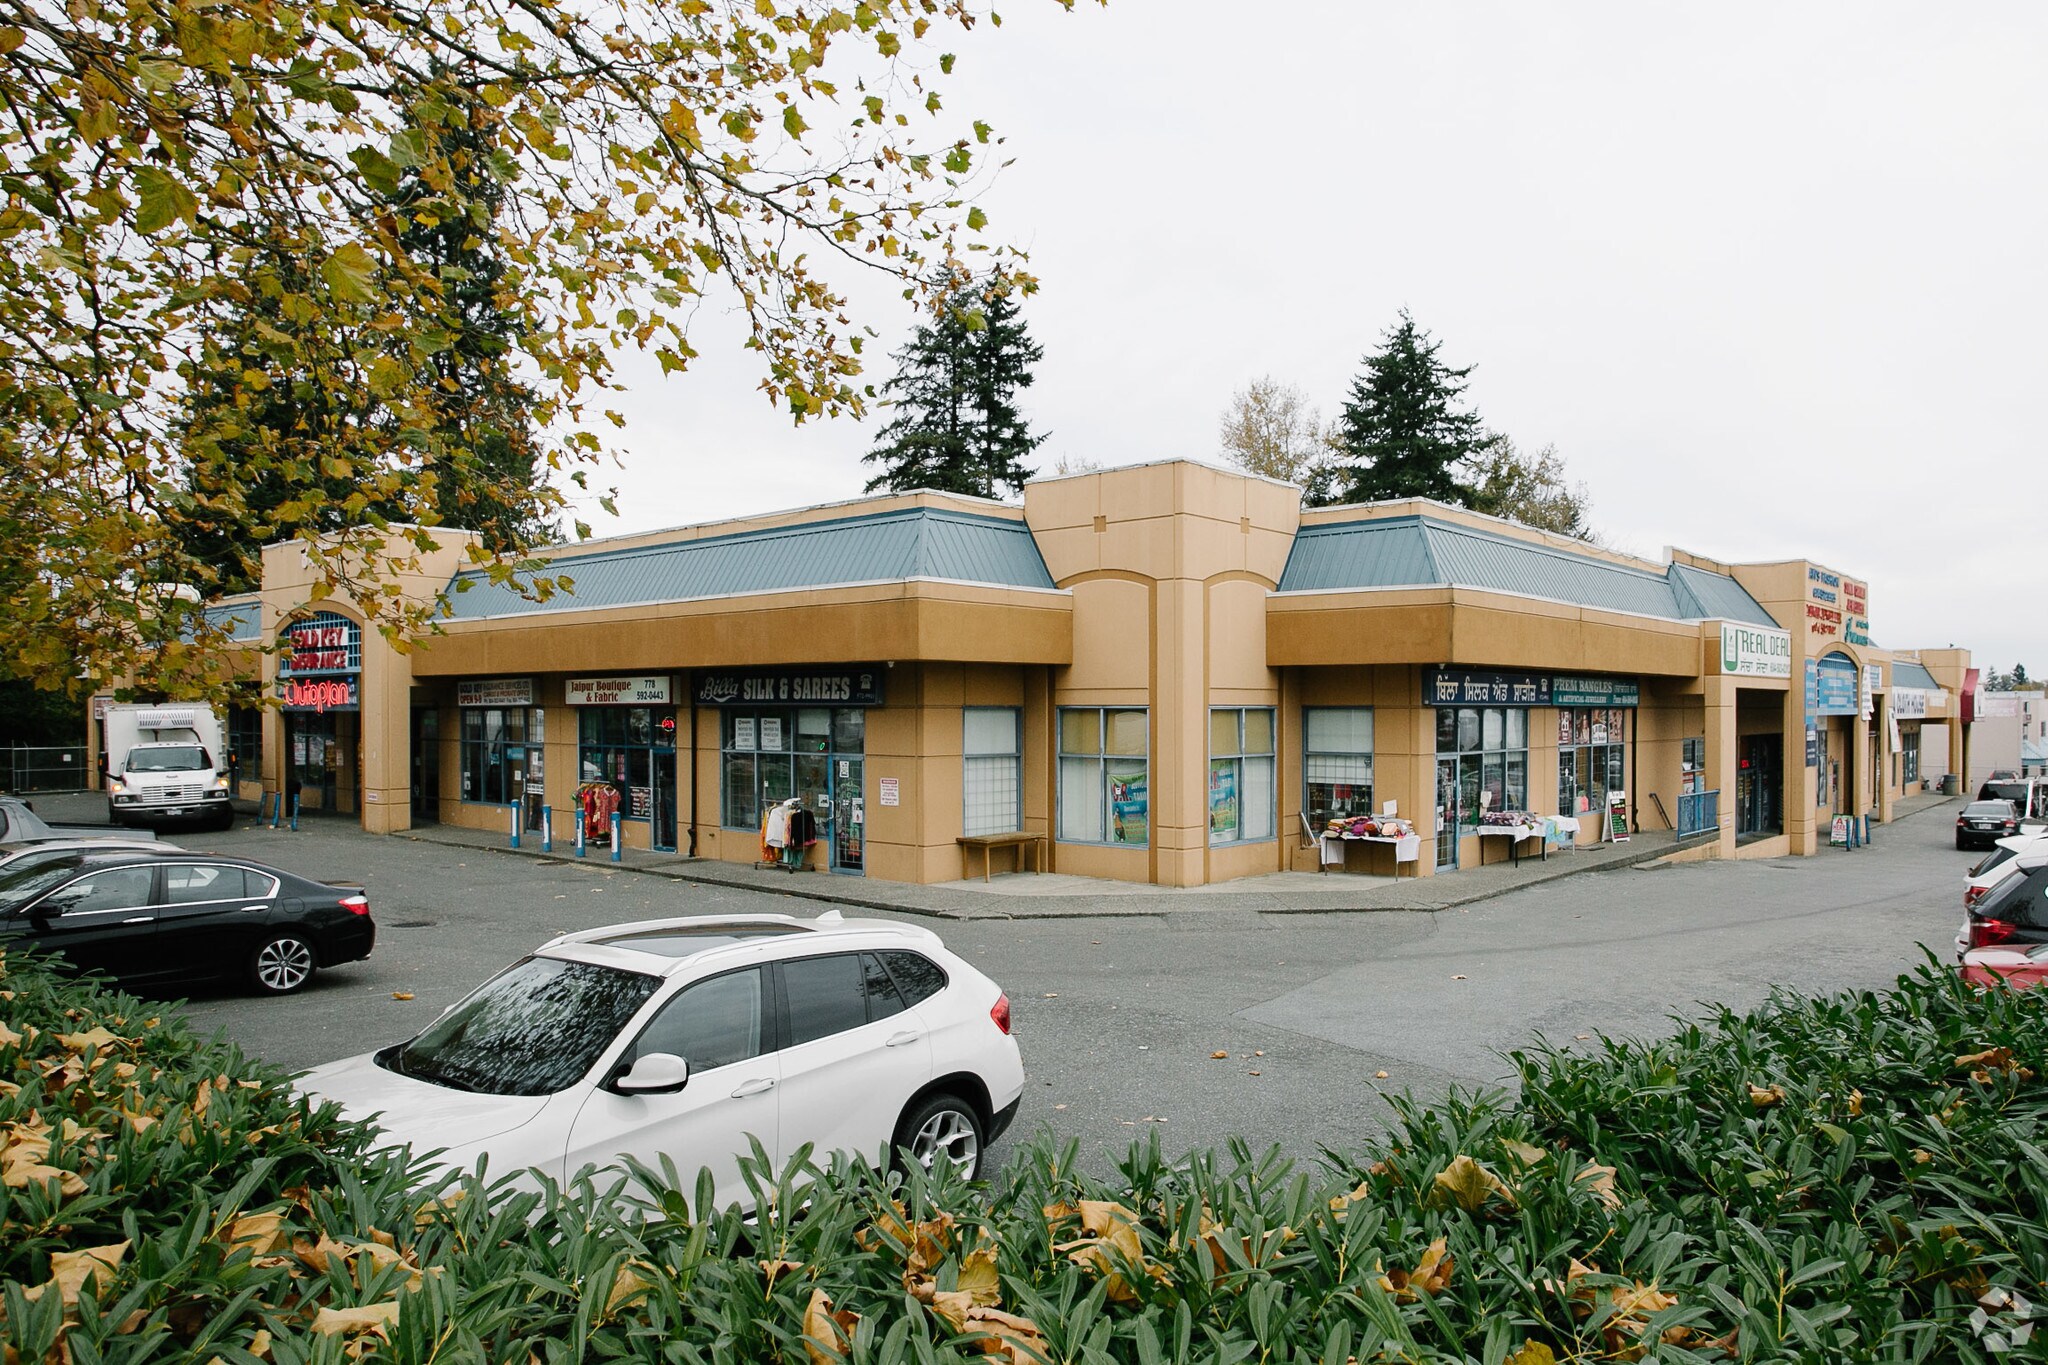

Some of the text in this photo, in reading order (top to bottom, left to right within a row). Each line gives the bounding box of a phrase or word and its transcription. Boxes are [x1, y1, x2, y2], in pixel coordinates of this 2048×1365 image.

[321, 627, 344, 647] KEY
[1741, 629, 1791, 657] REAL DEAL
[571, 680, 631, 693] Jaipur Boutique
[645, 680, 655, 689] 778
[700, 677, 850, 702] Billa SILK & SAREES
[1553, 678, 1577, 692] PREM
[1579, 680, 1612, 693] BANGLES
[284, 678, 348, 713] Autoplan
[585, 692, 618, 702] & Fabric
[636, 691, 664, 700] 592-0443
